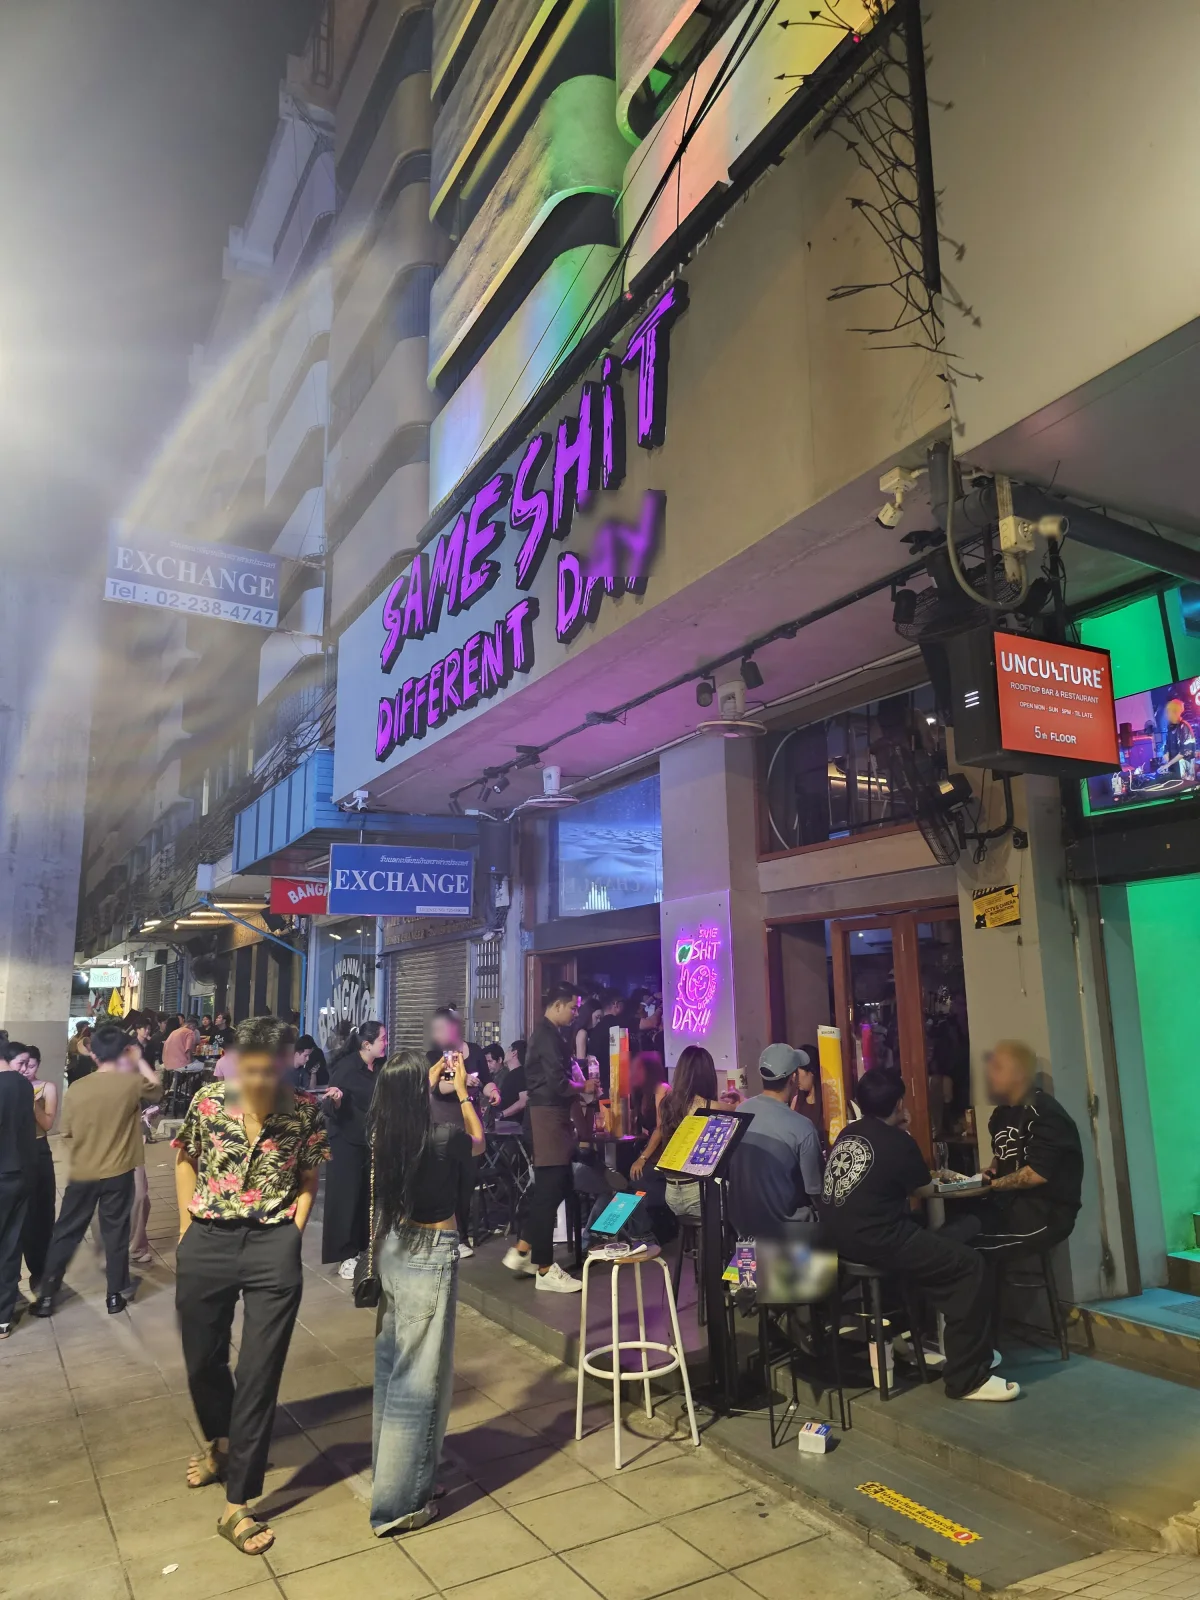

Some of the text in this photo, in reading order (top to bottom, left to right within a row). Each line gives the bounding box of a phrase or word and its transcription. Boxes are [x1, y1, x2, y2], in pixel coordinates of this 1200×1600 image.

[116, 546, 275, 599] EXCHANGE
[378, 473, 511, 674] SAME
[156, 590, 274, 625] 02-238-4747
[375, 598, 537, 761] DIFFERENT
[1000, 651, 1103, 688] UNCULTURE
[1010, 682, 1040, 693] ROOFTOP
[1041, 687, 1054, 697] BAR
[1060, 690, 1098, 704] RESTAURANT
[1019, 701, 1034, 709] OPEN
[1050, 732, 1077, 744] FLOOR
[334, 869, 469, 894] EXCHANGE
